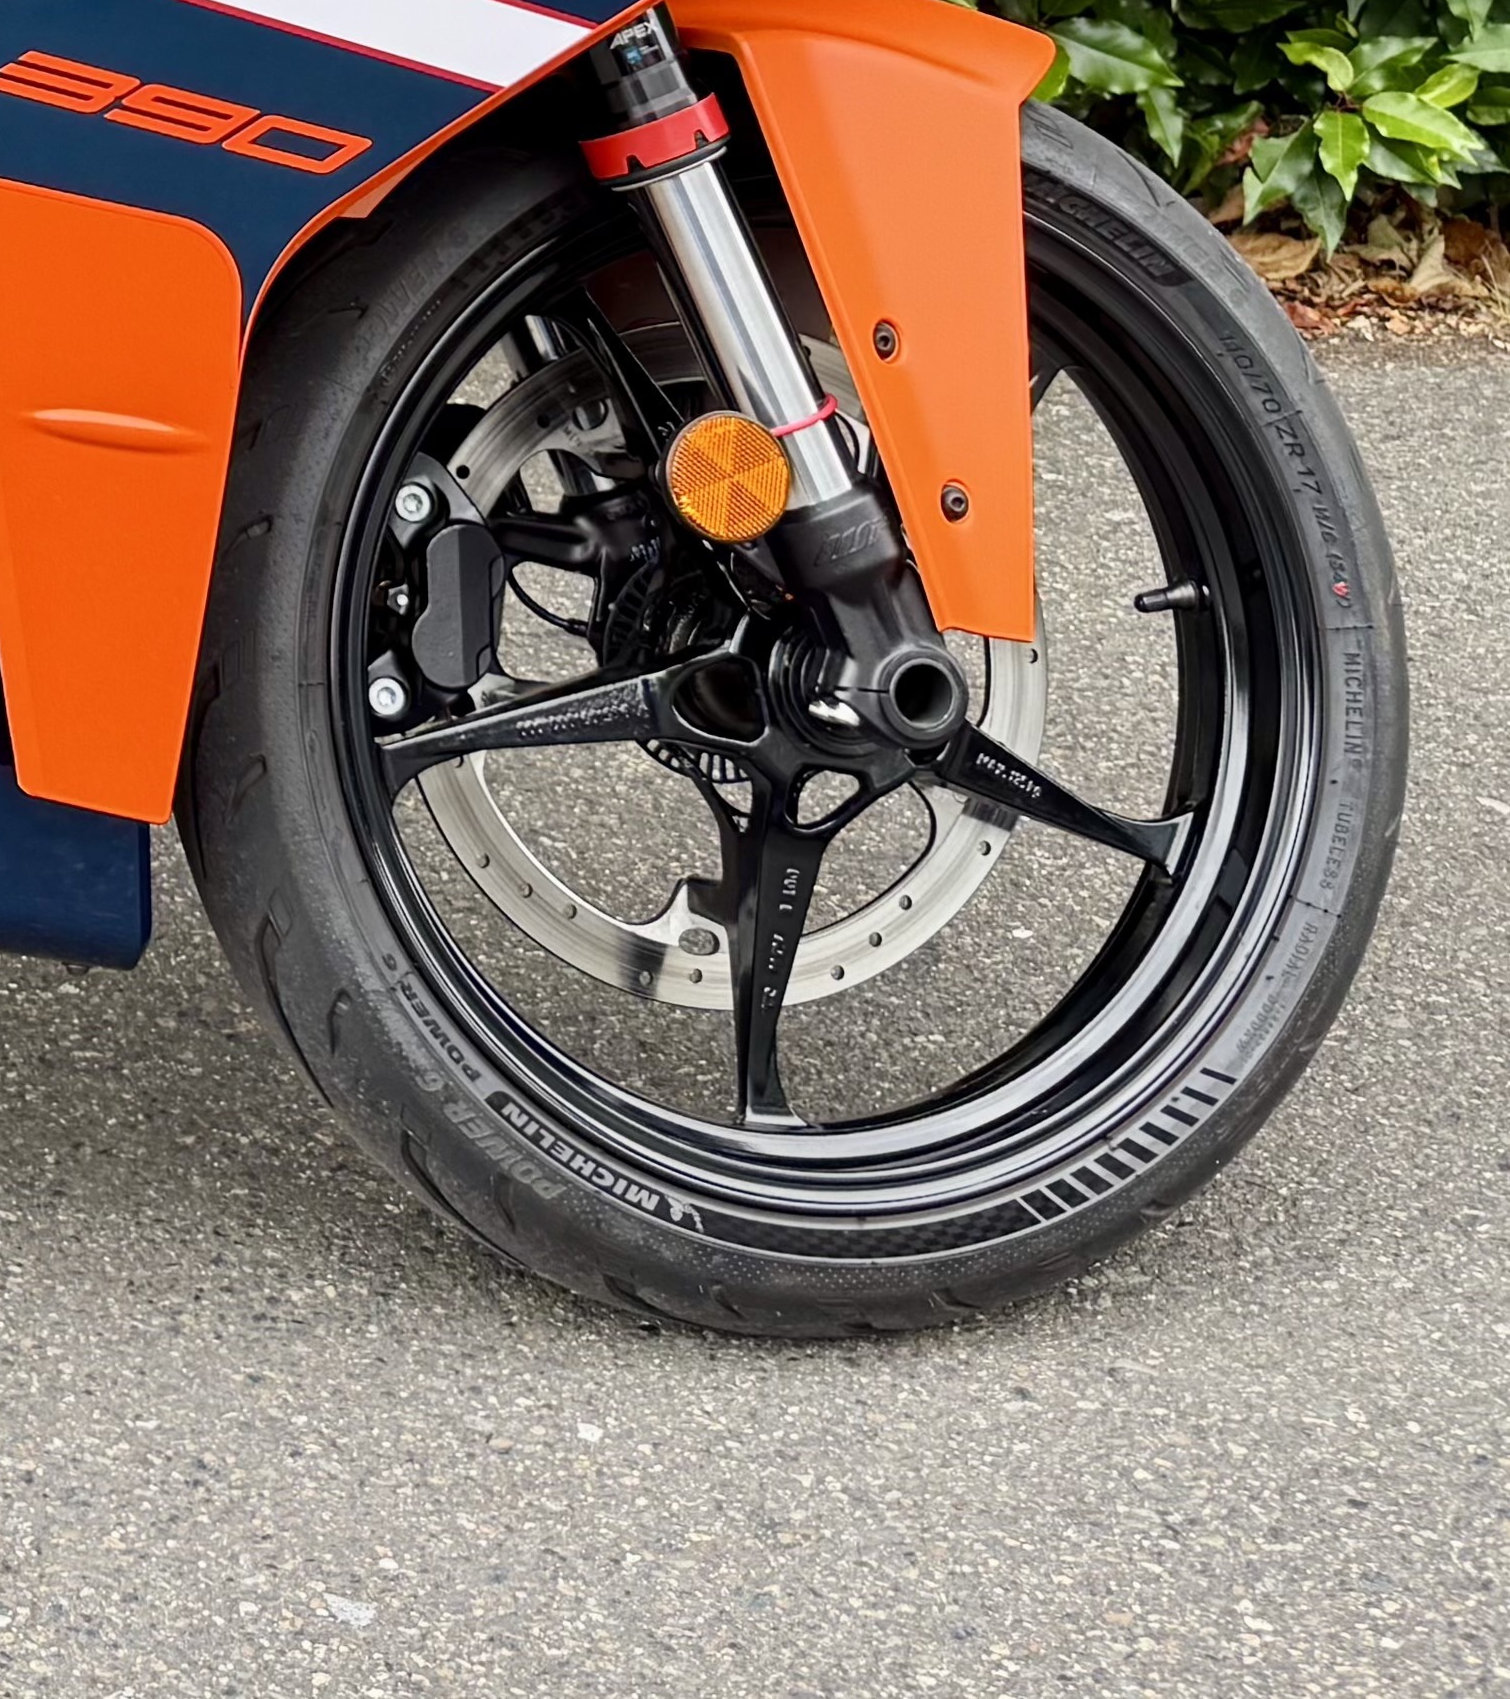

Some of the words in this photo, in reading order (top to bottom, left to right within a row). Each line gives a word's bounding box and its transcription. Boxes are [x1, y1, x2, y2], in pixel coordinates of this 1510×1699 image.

[609, 21, 659, 50] APEX
[1276, 416, 1306, 458] ZR
[1297, 468, 1323, 495] 17
[1342, 652, 1363, 756] MICHELIN
[1320, 801, 1354, 891] TUBELESS
[381, 952, 397, 973] 6
[398, 980, 482, 1083] POWER
[414, 1070, 445, 1093] 6
[442, 1099, 568, 1200] POWER
[500, 1100, 662, 1212] MICHELIN
